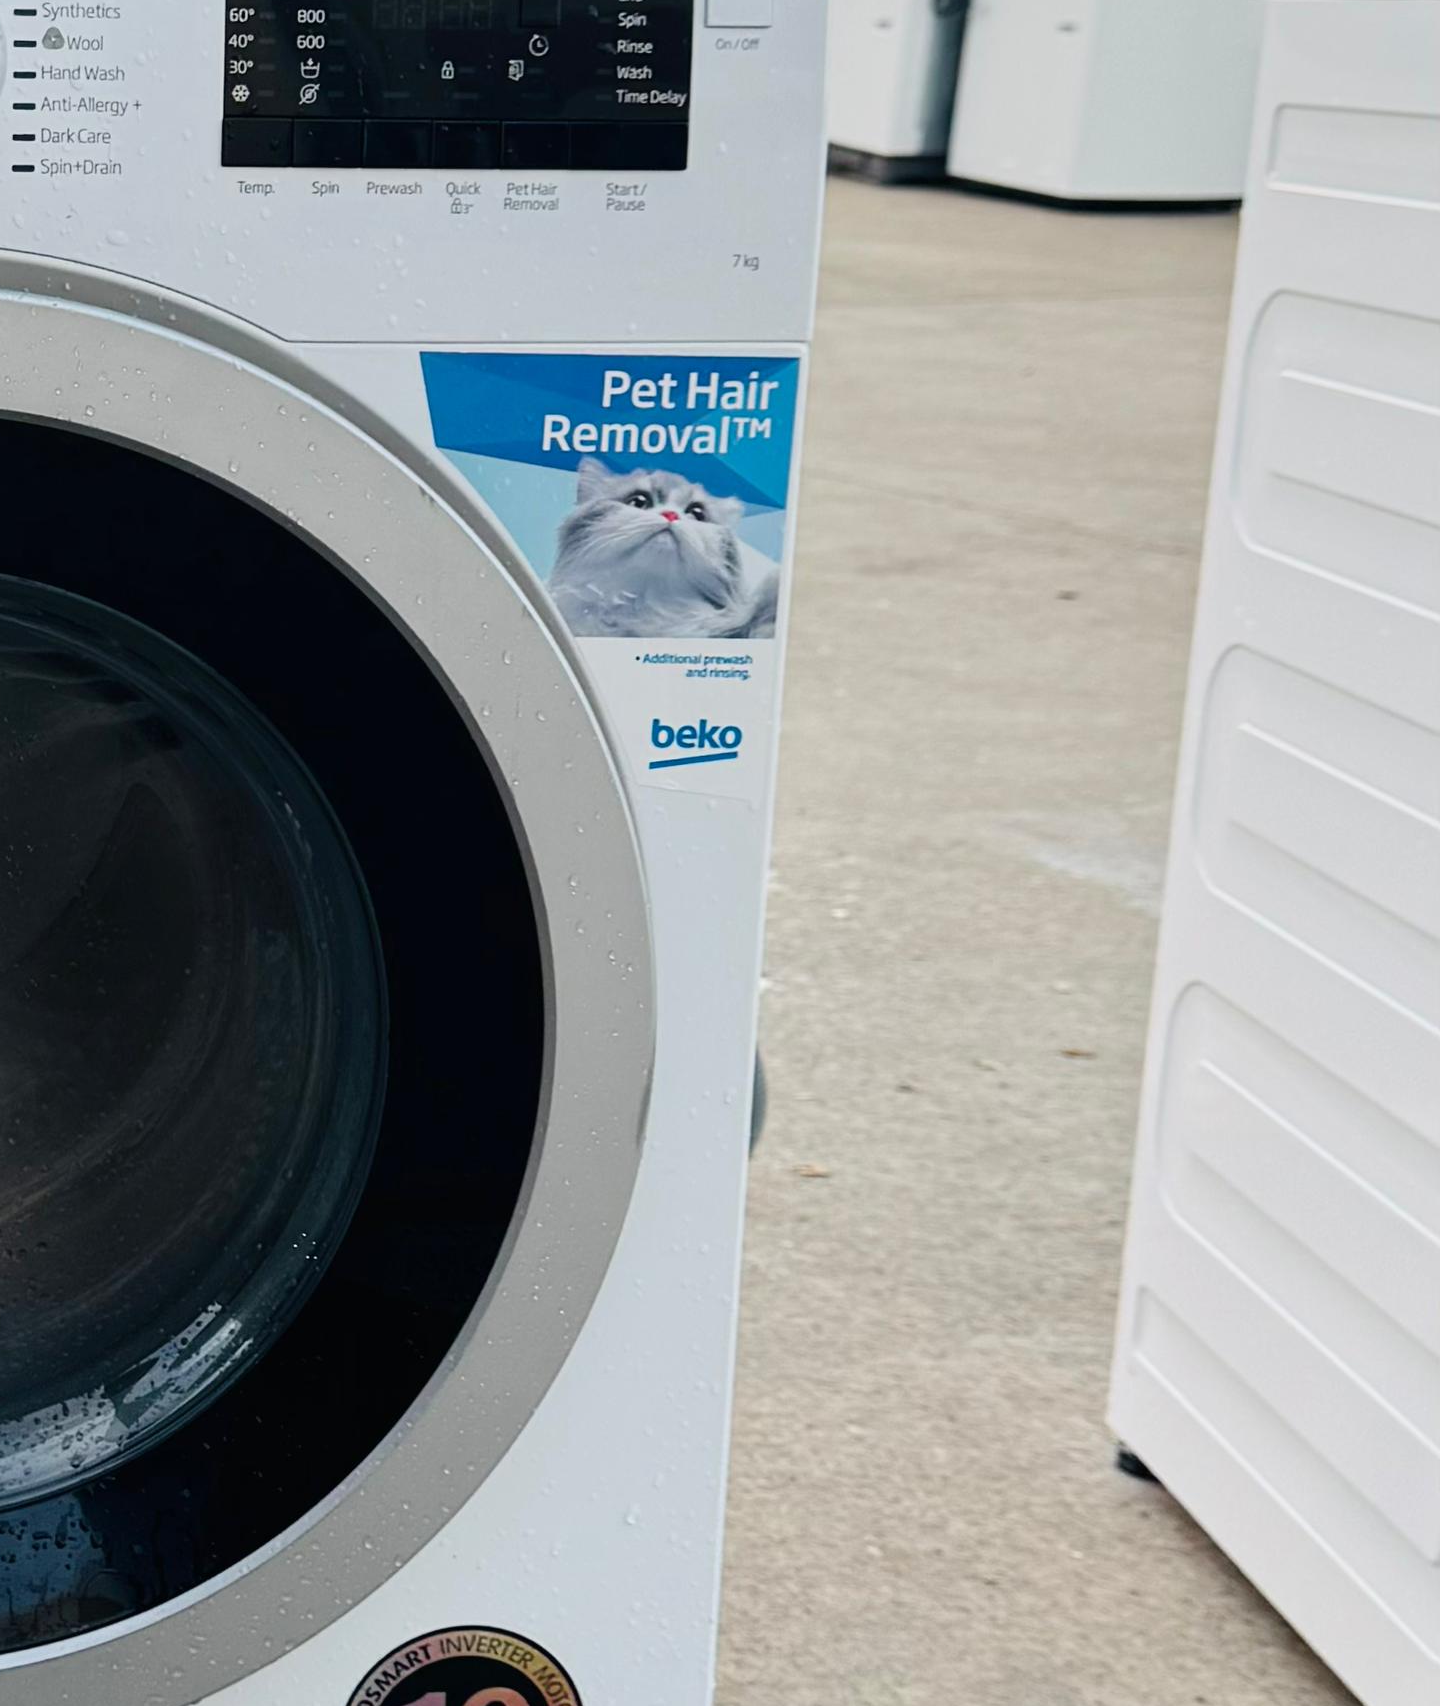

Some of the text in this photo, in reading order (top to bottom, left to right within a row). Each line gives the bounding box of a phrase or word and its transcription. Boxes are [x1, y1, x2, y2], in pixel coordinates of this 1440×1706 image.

[41, 2, 121, 22] Synthetics
[297, 9, 326, 23] 800
[617, 13, 647, 29] Spin
[67, 35, 104, 52] Wool
[296, 35, 325, 49] 600
[617, 39, 653, 55] Rinse
[41, 64, 126, 83] Hand Wash
[616, 65, 653, 81] Wash
[40, 96, 129, 117] Anti-Allergy
[616, 89, 687, 108] Time Delay
[40, 128, 112, 146] Dark Care
[40, 159, 122, 178] Spin+Drain
[238, 181, 275, 198] Temp.
[312, 181, 340, 197] Spin
[366, 181, 422, 195] Prewash
[446, 181, 481, 197] Quick
[506, 182, 558, 196] Pet Hair
[504, 198, 559, 211] Removal
[606, 198, 646, 211] Pause
[732, 253, 760, 271] 7 kg
[602, 370, 780, 411] Pet Hair
[643, 653, 753, 665] Additional prewash
[685, 668, 707, 677] and
[651, 718, 742, 750] beko
[440, 1634, 534, 1670] INVERTER
